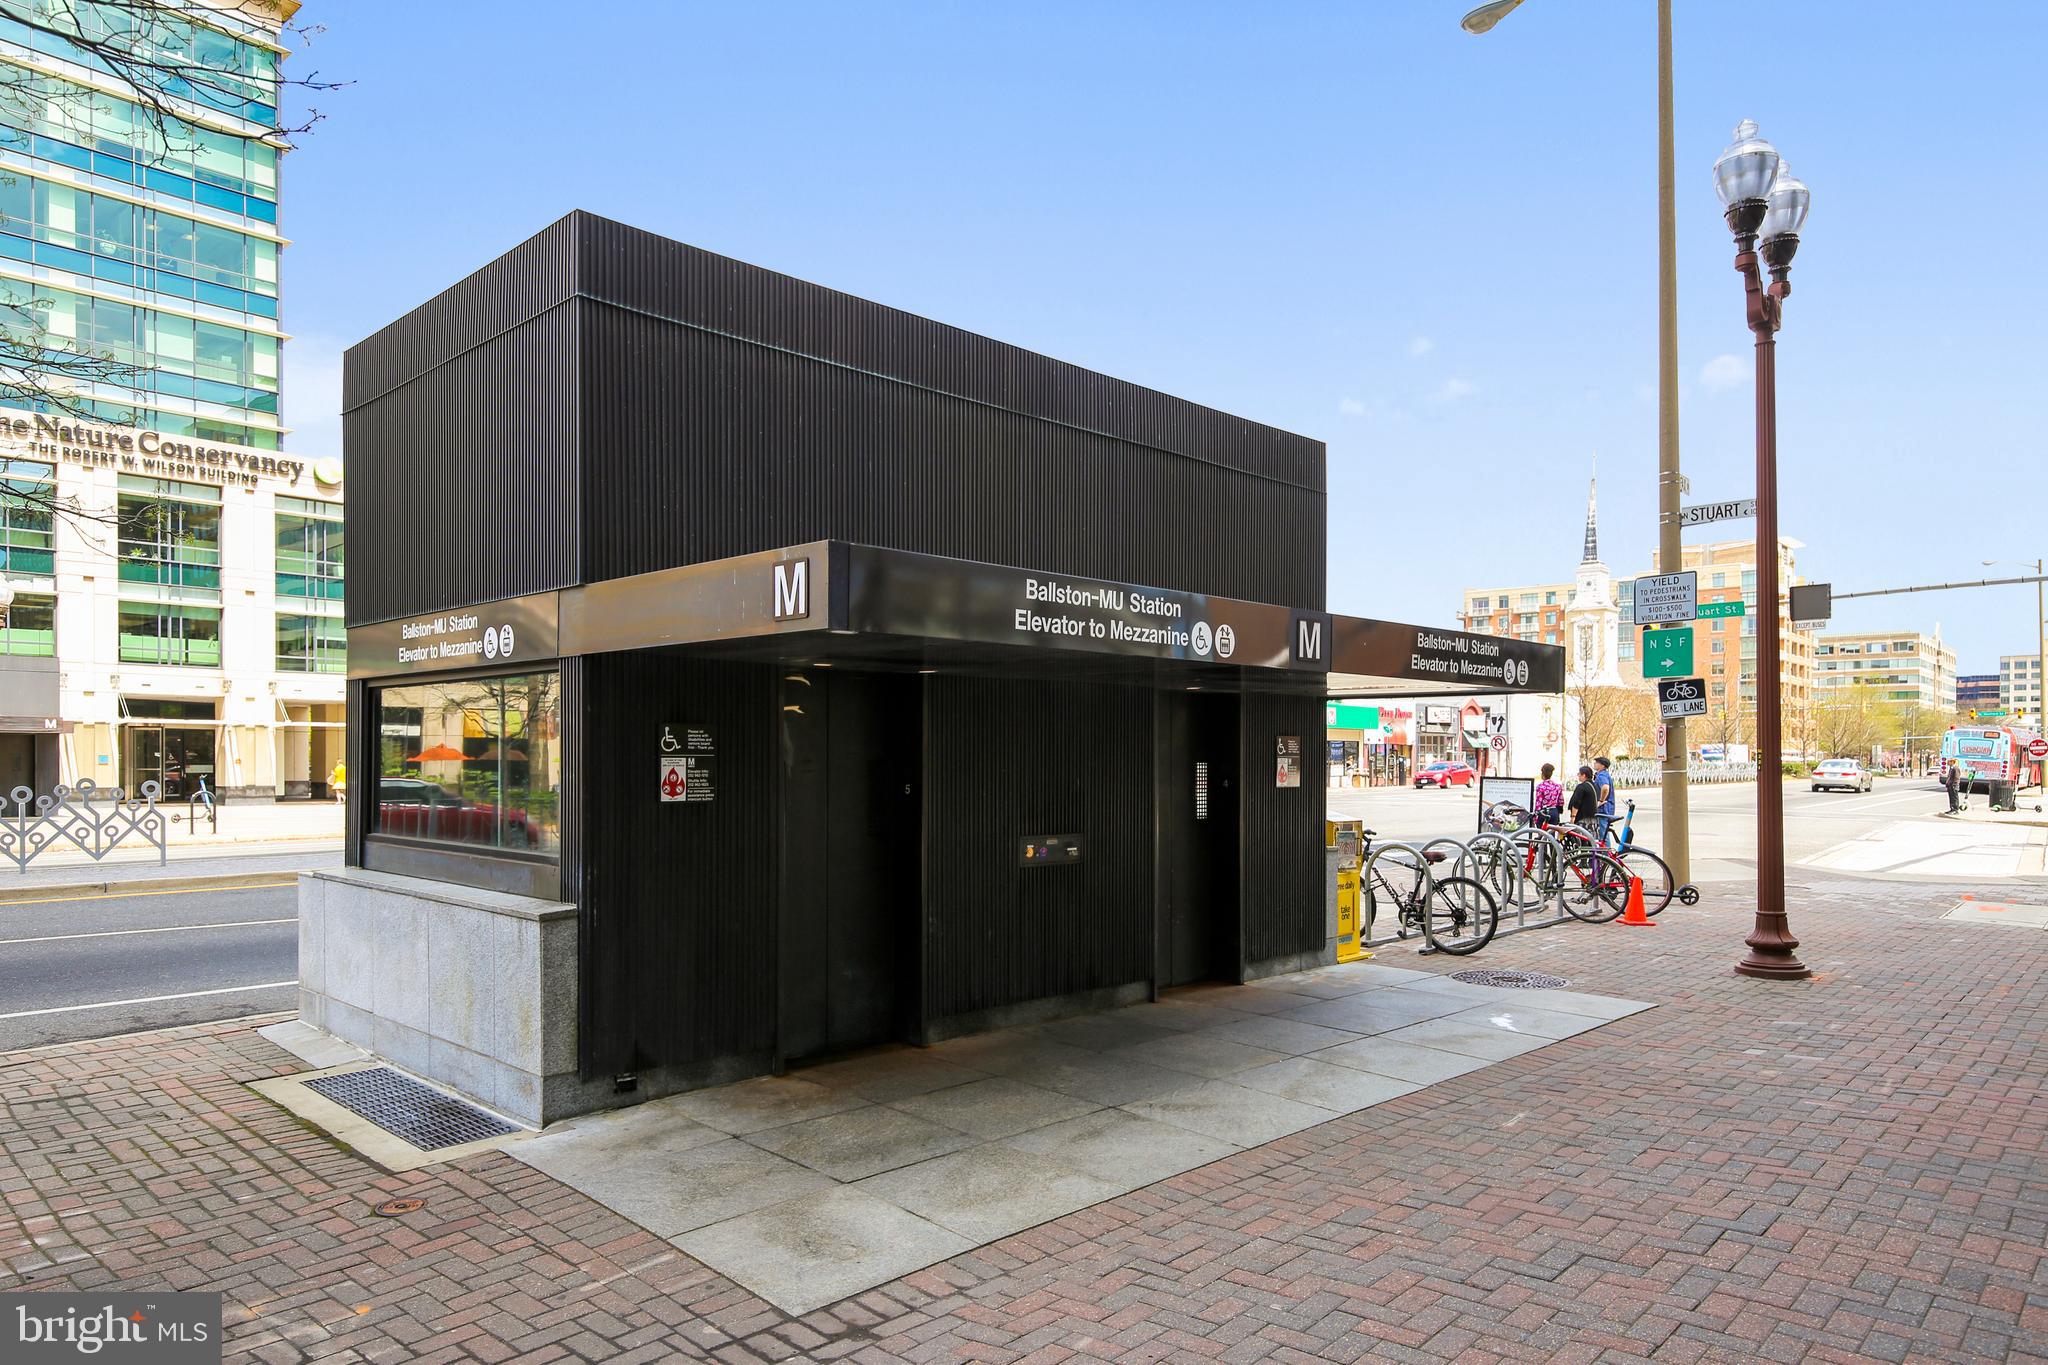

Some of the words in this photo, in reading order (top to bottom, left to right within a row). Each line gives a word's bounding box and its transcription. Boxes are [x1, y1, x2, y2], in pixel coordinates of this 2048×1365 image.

[33, 414, 134, 452] Nature
[139, 431, 304, 482] Conservancy
[29, 441, 57, 454] THE
[62, 446, 117, 463] ROBERT
[143, 458, 195, 475] WILSON
[200, 467, 258, 484] BUILDING
[1691, 503, 1740, 522] STUART
[774, 561, 805, 617] M
[1650, 584, 1691, 595] PEDESTRIANS
[1652, 576, 1680, 587] YIELD
[1026, 578, 1124, 611] Ballston-MU
[1130, 592, 1181, 618] Station
[1652, 593, 1687, 603] CROSSWALK
[1641, 612, 1673, 622] VIOLATION
[1724, 605, 1740, 614] St.
[402, 617, 447, 640] Ballston-MU
[449, 614, 478, 633] Station
[1015, 608, 1085, 636] Elevator
[1089, 618, 1105, 639] to
[1110, 619, 1189, 647] Mezzanine
[1299, 620, 1321, 660] M
[1417, 632, 1469, 653] Ballston-MU
[1471, 640, 1499, 657] Station
[1650, 639, 1657, 649] N
[1665, 638, 1672, 648] S
[1680, 636, 1686, 647] F
[398, 645, 429, 663] Elevator
[430, 644, 438, 659] to
[440, 638, 483, 658] Mezzanine
[1411, 654, 1448, 673] Elevator
[1450, 658, 1459, 673] to
[1461, 660, 1503, 678] Mezzanine
[1663, 703, 1679, 714] BIKE
[1684, 701, 1705, 712] LANE
[44, 718, 57, 729] M
[904, 783, 911, 795] 5
[1340, 905, 1351, 914] take
